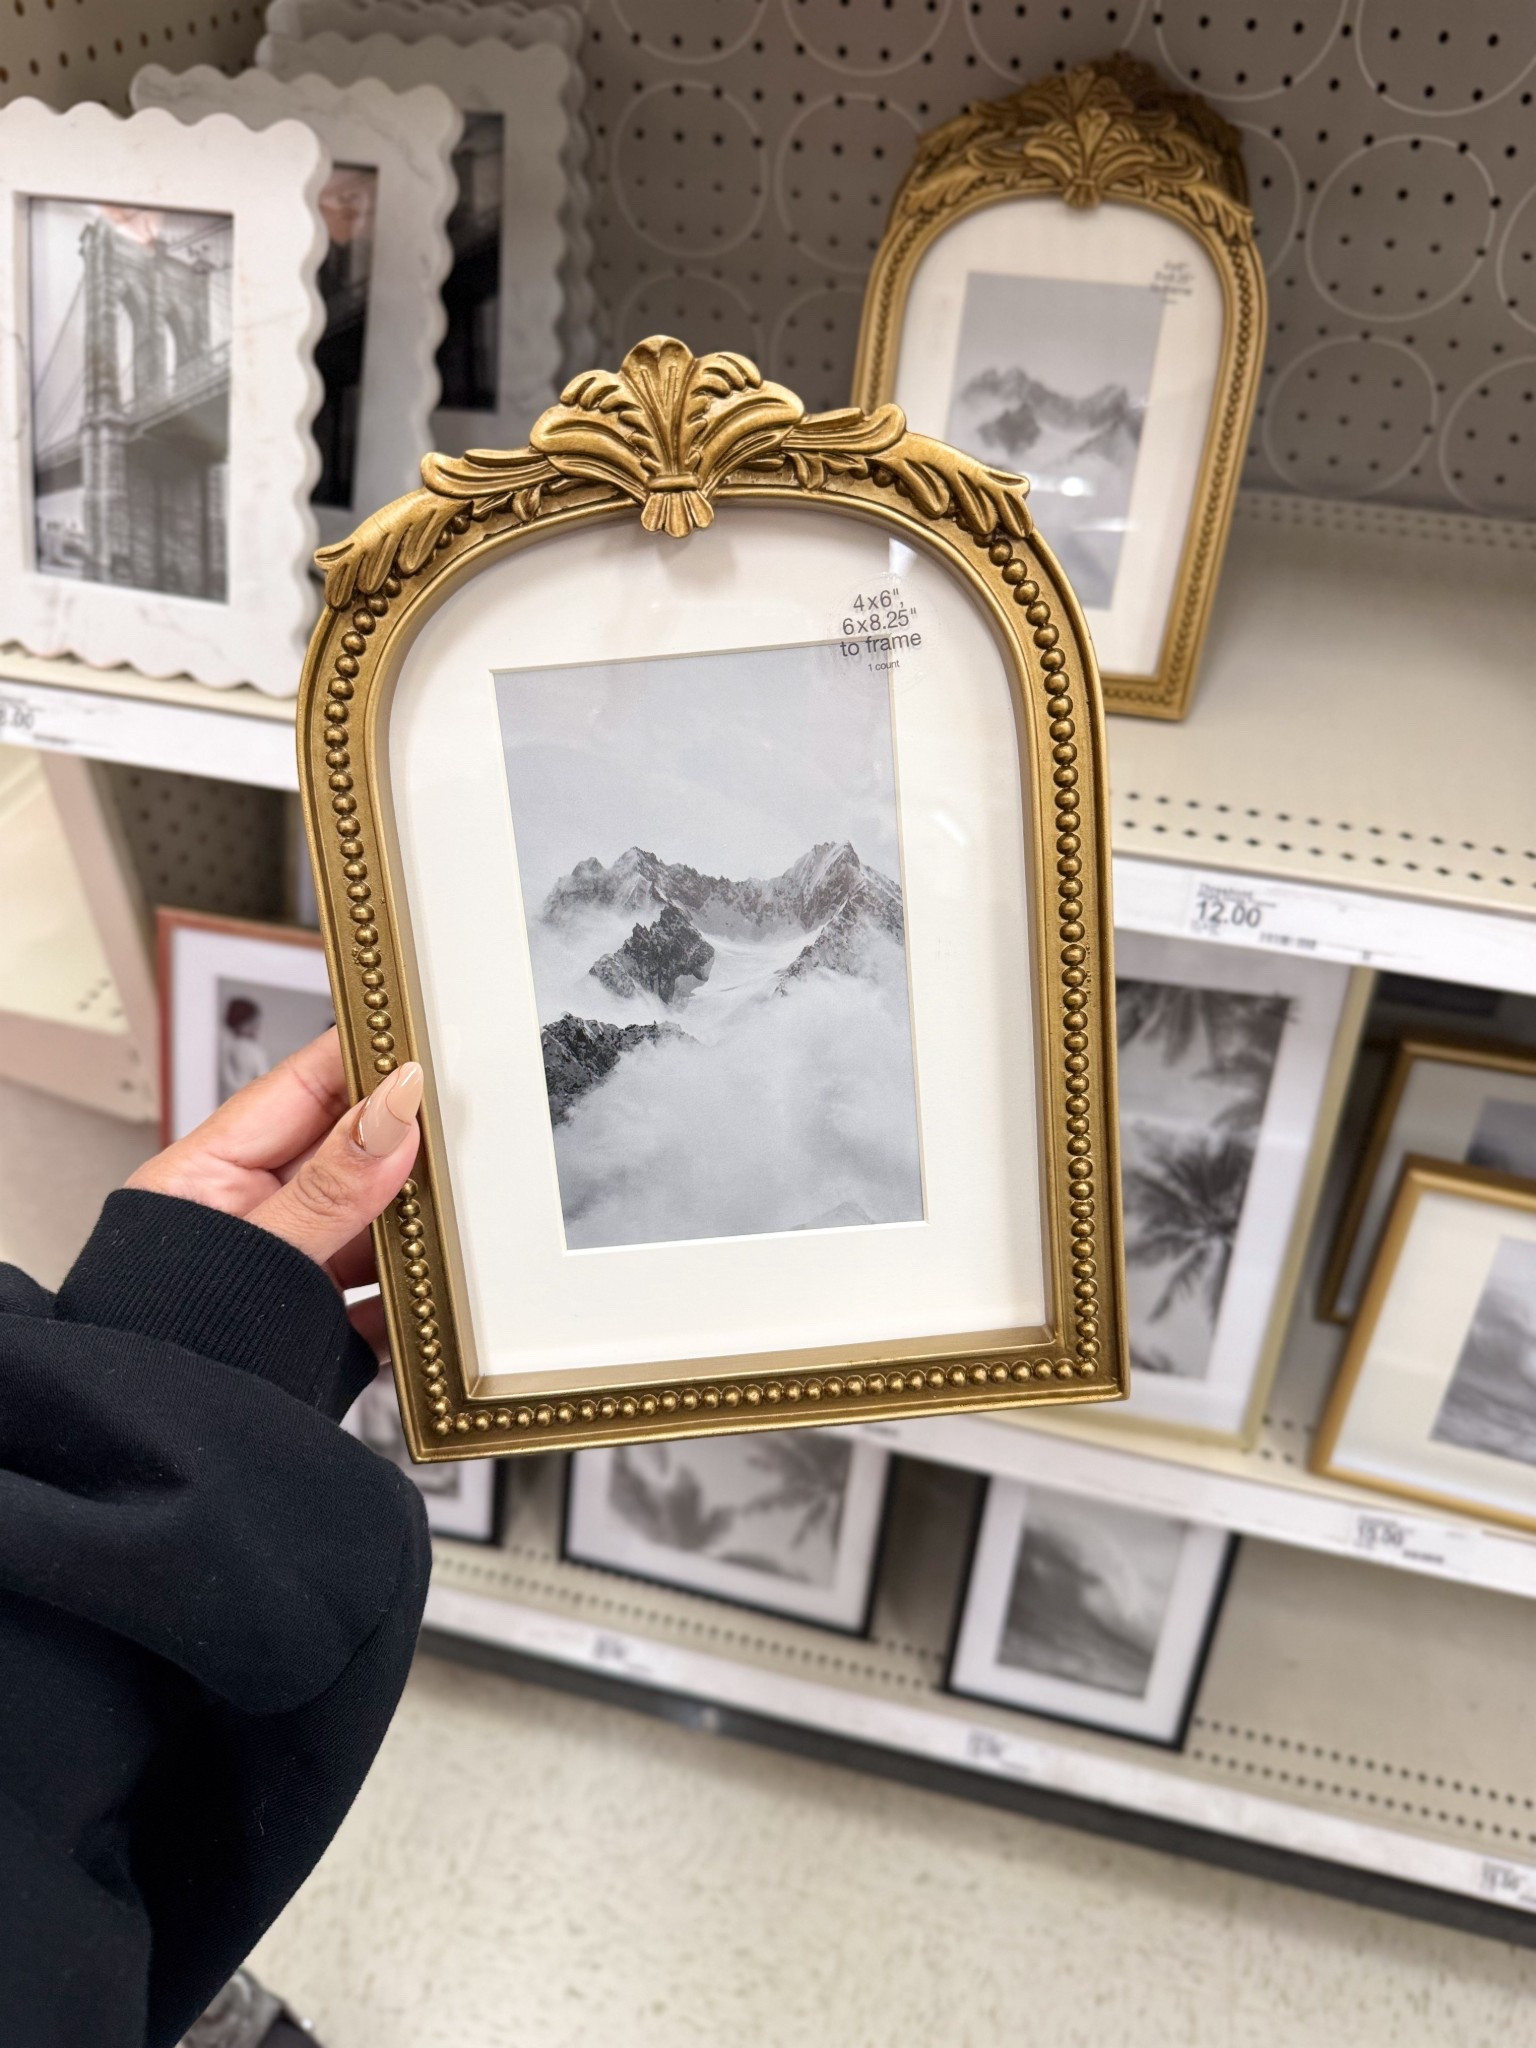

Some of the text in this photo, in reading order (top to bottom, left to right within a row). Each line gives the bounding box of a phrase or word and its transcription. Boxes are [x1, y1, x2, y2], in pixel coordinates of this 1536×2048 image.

[853, 587, 904, 612] 4x6",
[842, 607, 917, 635] 6x8.25"
[840, 633, 922, 656] to frame
[868, 660, 900, 672] 1 count
[1198, 900, 1262, 928] 12.00
